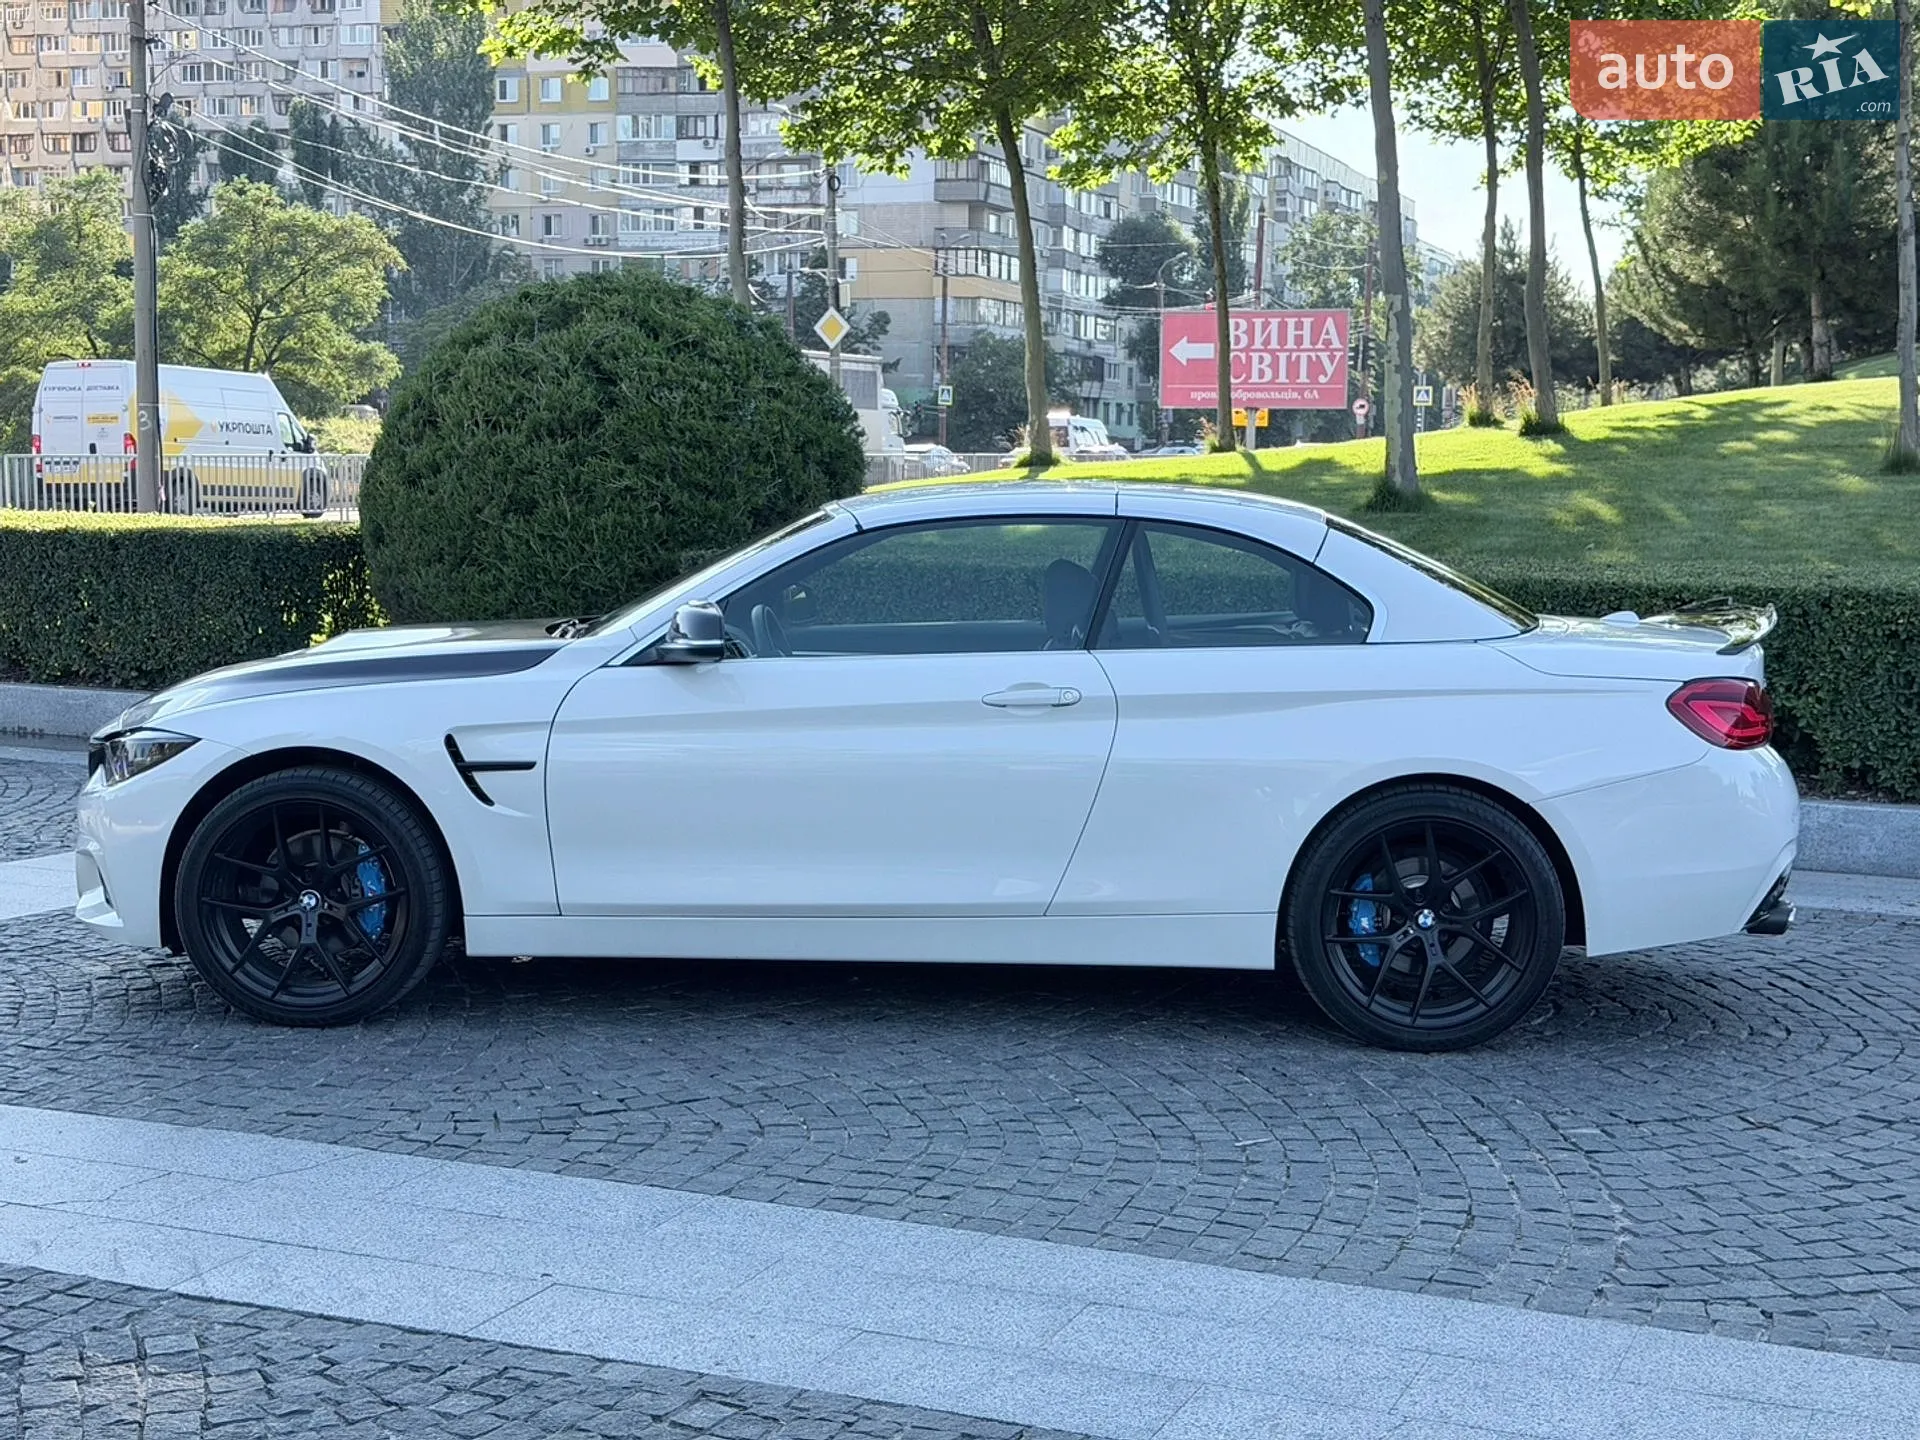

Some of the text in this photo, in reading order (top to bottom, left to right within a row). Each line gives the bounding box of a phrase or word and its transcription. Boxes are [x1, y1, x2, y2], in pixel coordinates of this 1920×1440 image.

[1229, 316, 1344, 350] ВИНА
[1230, 351, 1344, 384] СВІТУ
[1303, 389, 1320, 400] 6А
[217, 420, 274, 436] УКРПОШТА
